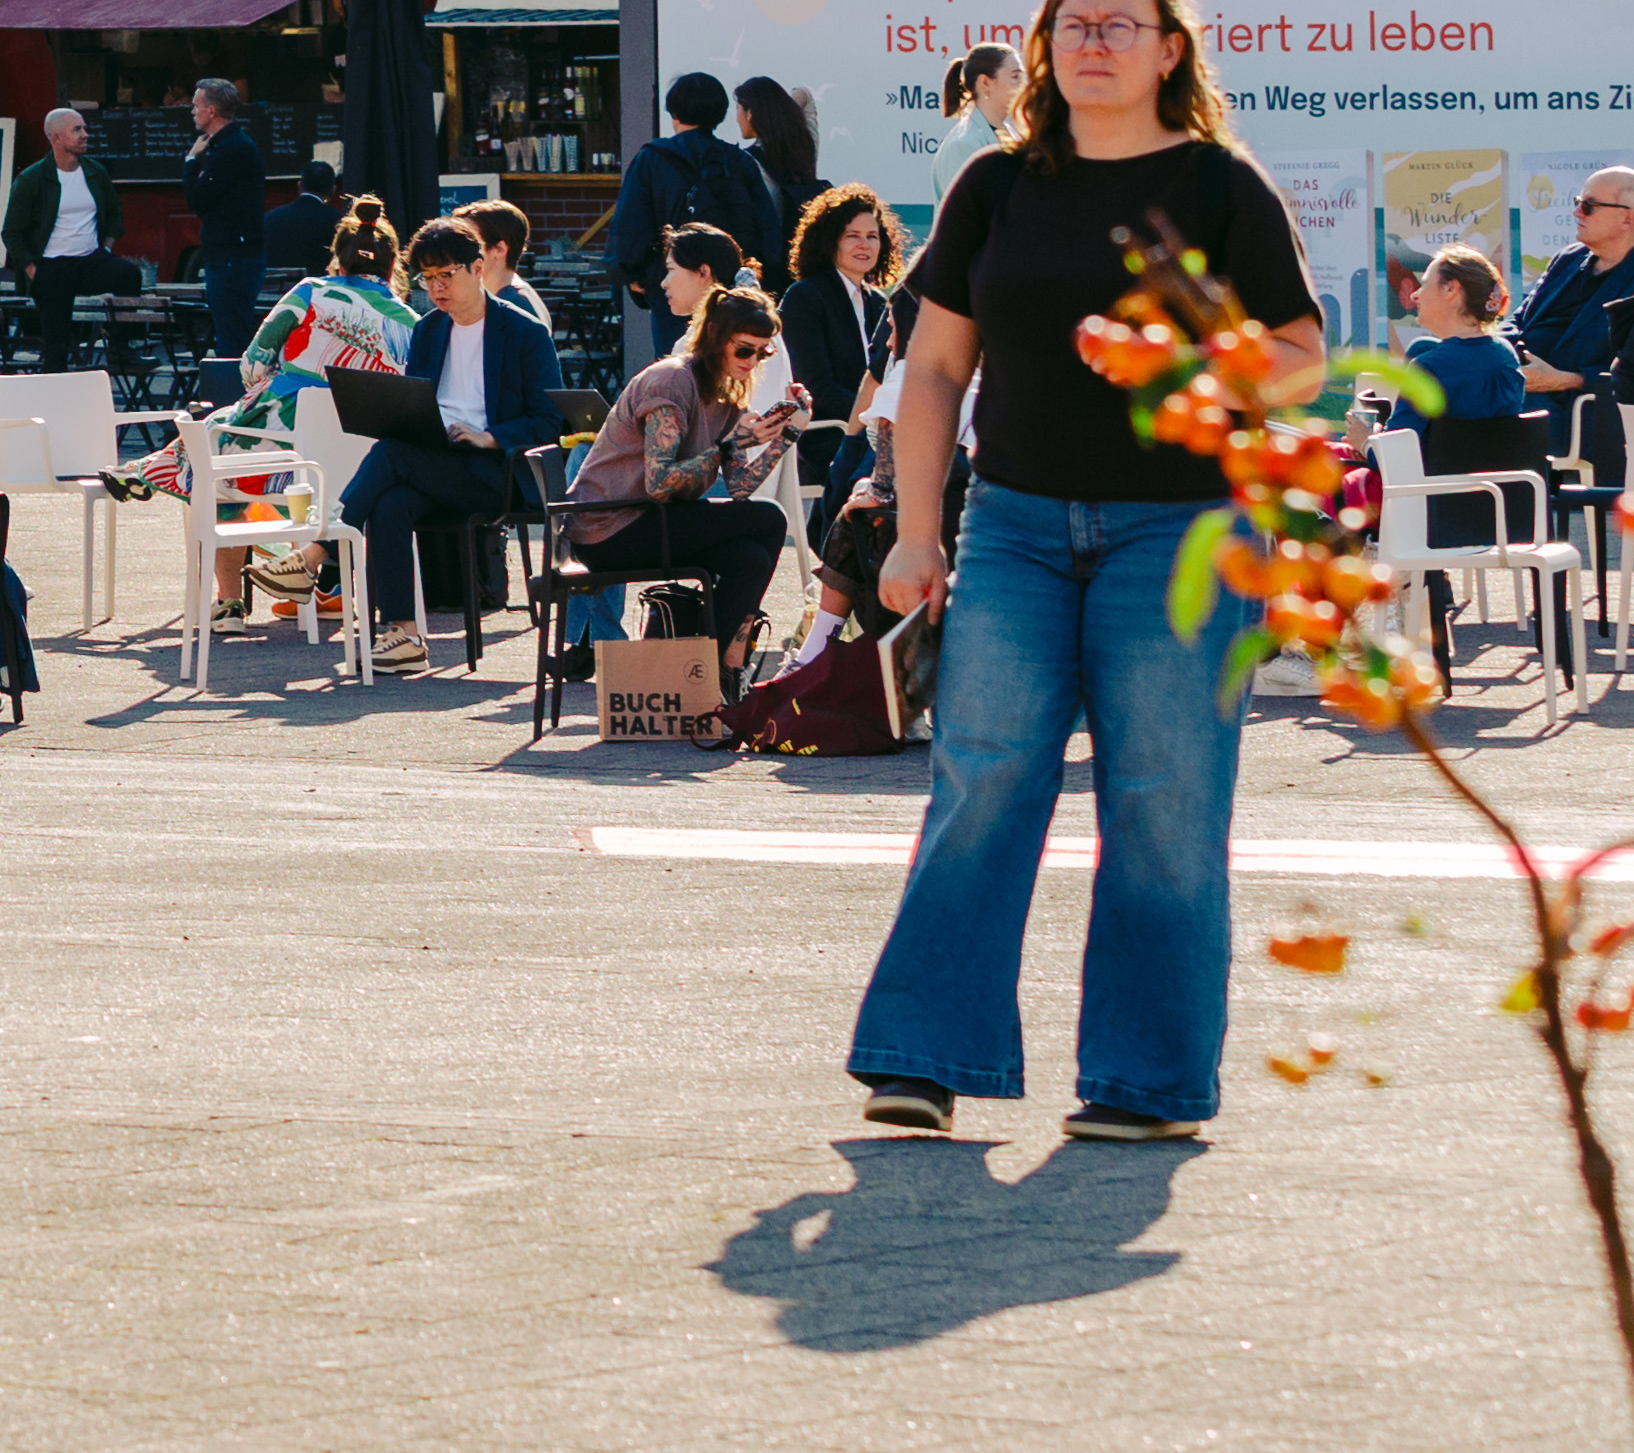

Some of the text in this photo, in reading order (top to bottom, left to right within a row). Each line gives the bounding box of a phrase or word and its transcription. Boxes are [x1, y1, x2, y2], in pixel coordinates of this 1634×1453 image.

[886, 14, 948, 58] ist,
[964, 25, 1024, 45] um
[1307, 22, 1353, 52] zu
[1370, 10, 1494, 52] leben
[1265, 86, 1326, 117] Weg
[1334, 84, 1485, 114] verlassen,
[1494, 92, 1538, 110] um
[1547, 92, 1600, 110] ans
[1608, 85, 1634, 110] Zi
[1293, 179, 1319, 191] DAS
[1430, 192, 1452, 204] DIE
[1425, 233, 1460, 244] LISTE
[610, 692, 681, 713] BUCH
[610, 715, 714, 736] HALTER
